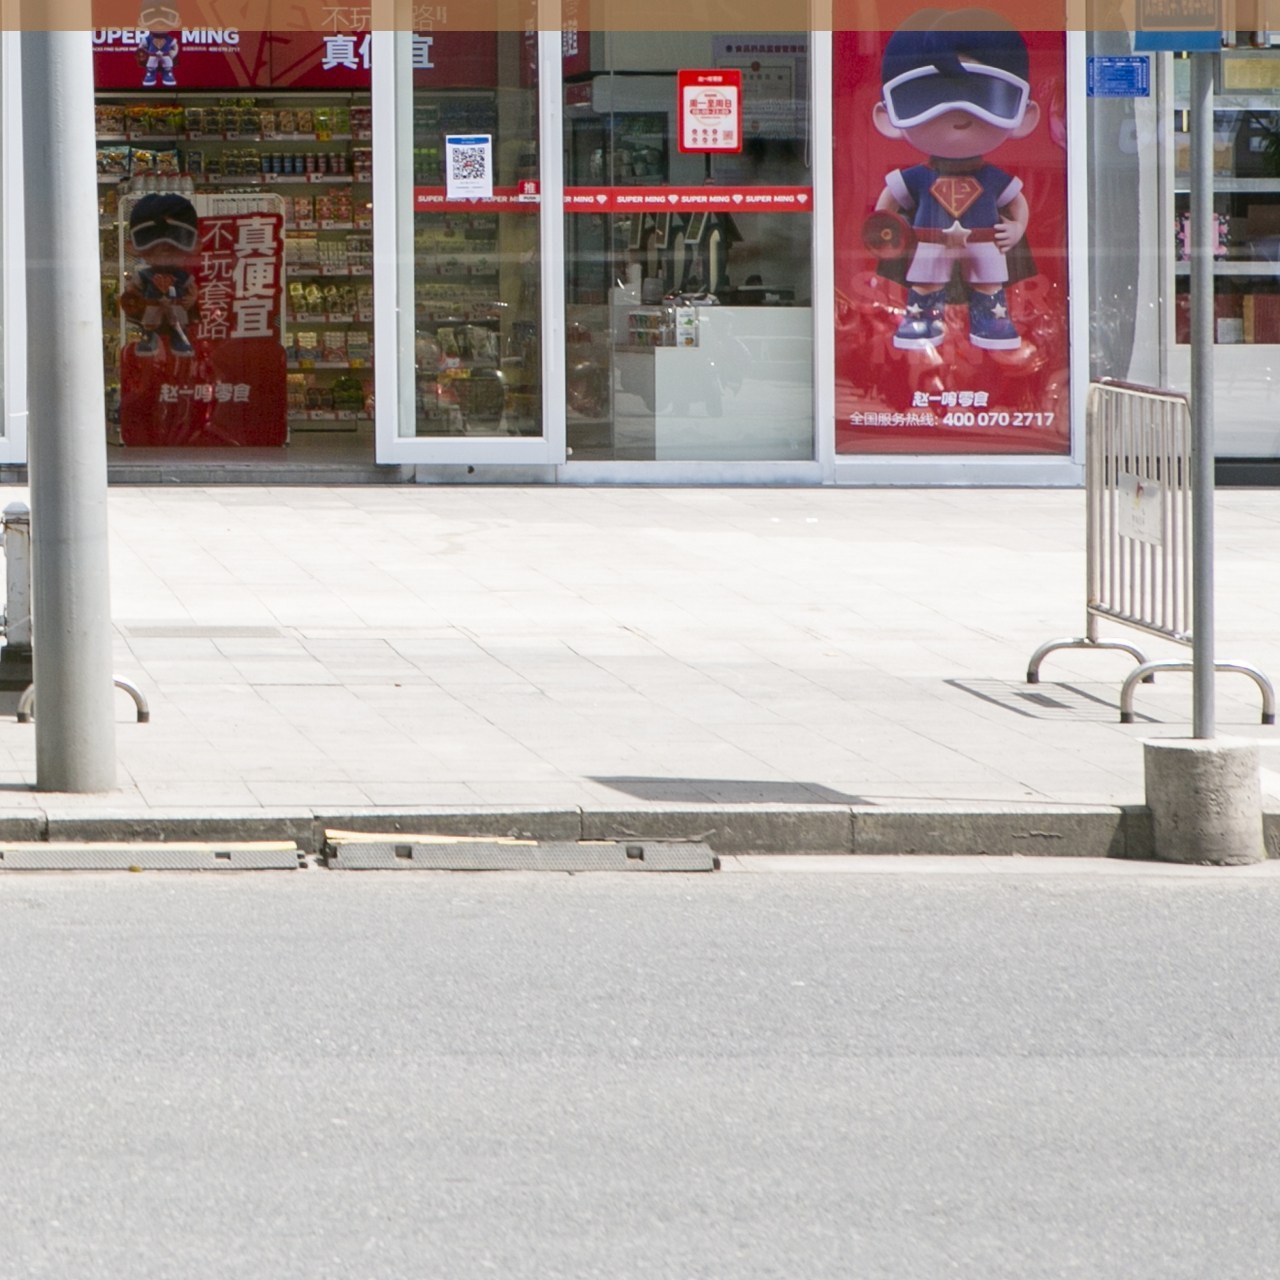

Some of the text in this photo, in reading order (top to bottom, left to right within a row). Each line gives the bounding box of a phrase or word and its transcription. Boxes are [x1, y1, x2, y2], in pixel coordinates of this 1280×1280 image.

[92, 26, 240, 45] UPER MING
[524, 181, 537, 194] 推
[417, 195, 444, 203] SUPER
[573, 195, 794, 204] MING SUPER MING SUPER MING
[197, 220, 233, 340] 不玩套路
[231, 216, 278, 339] 真便宜
[159, 382, 251, 403] 赵一鸣零食
[912, 390, 989, 408] 赵一鸣零食
[942, 412, 975, 427] 400
[978, 412, 1010, 427] 070
[1015, 412, 1055, 426] 2717
